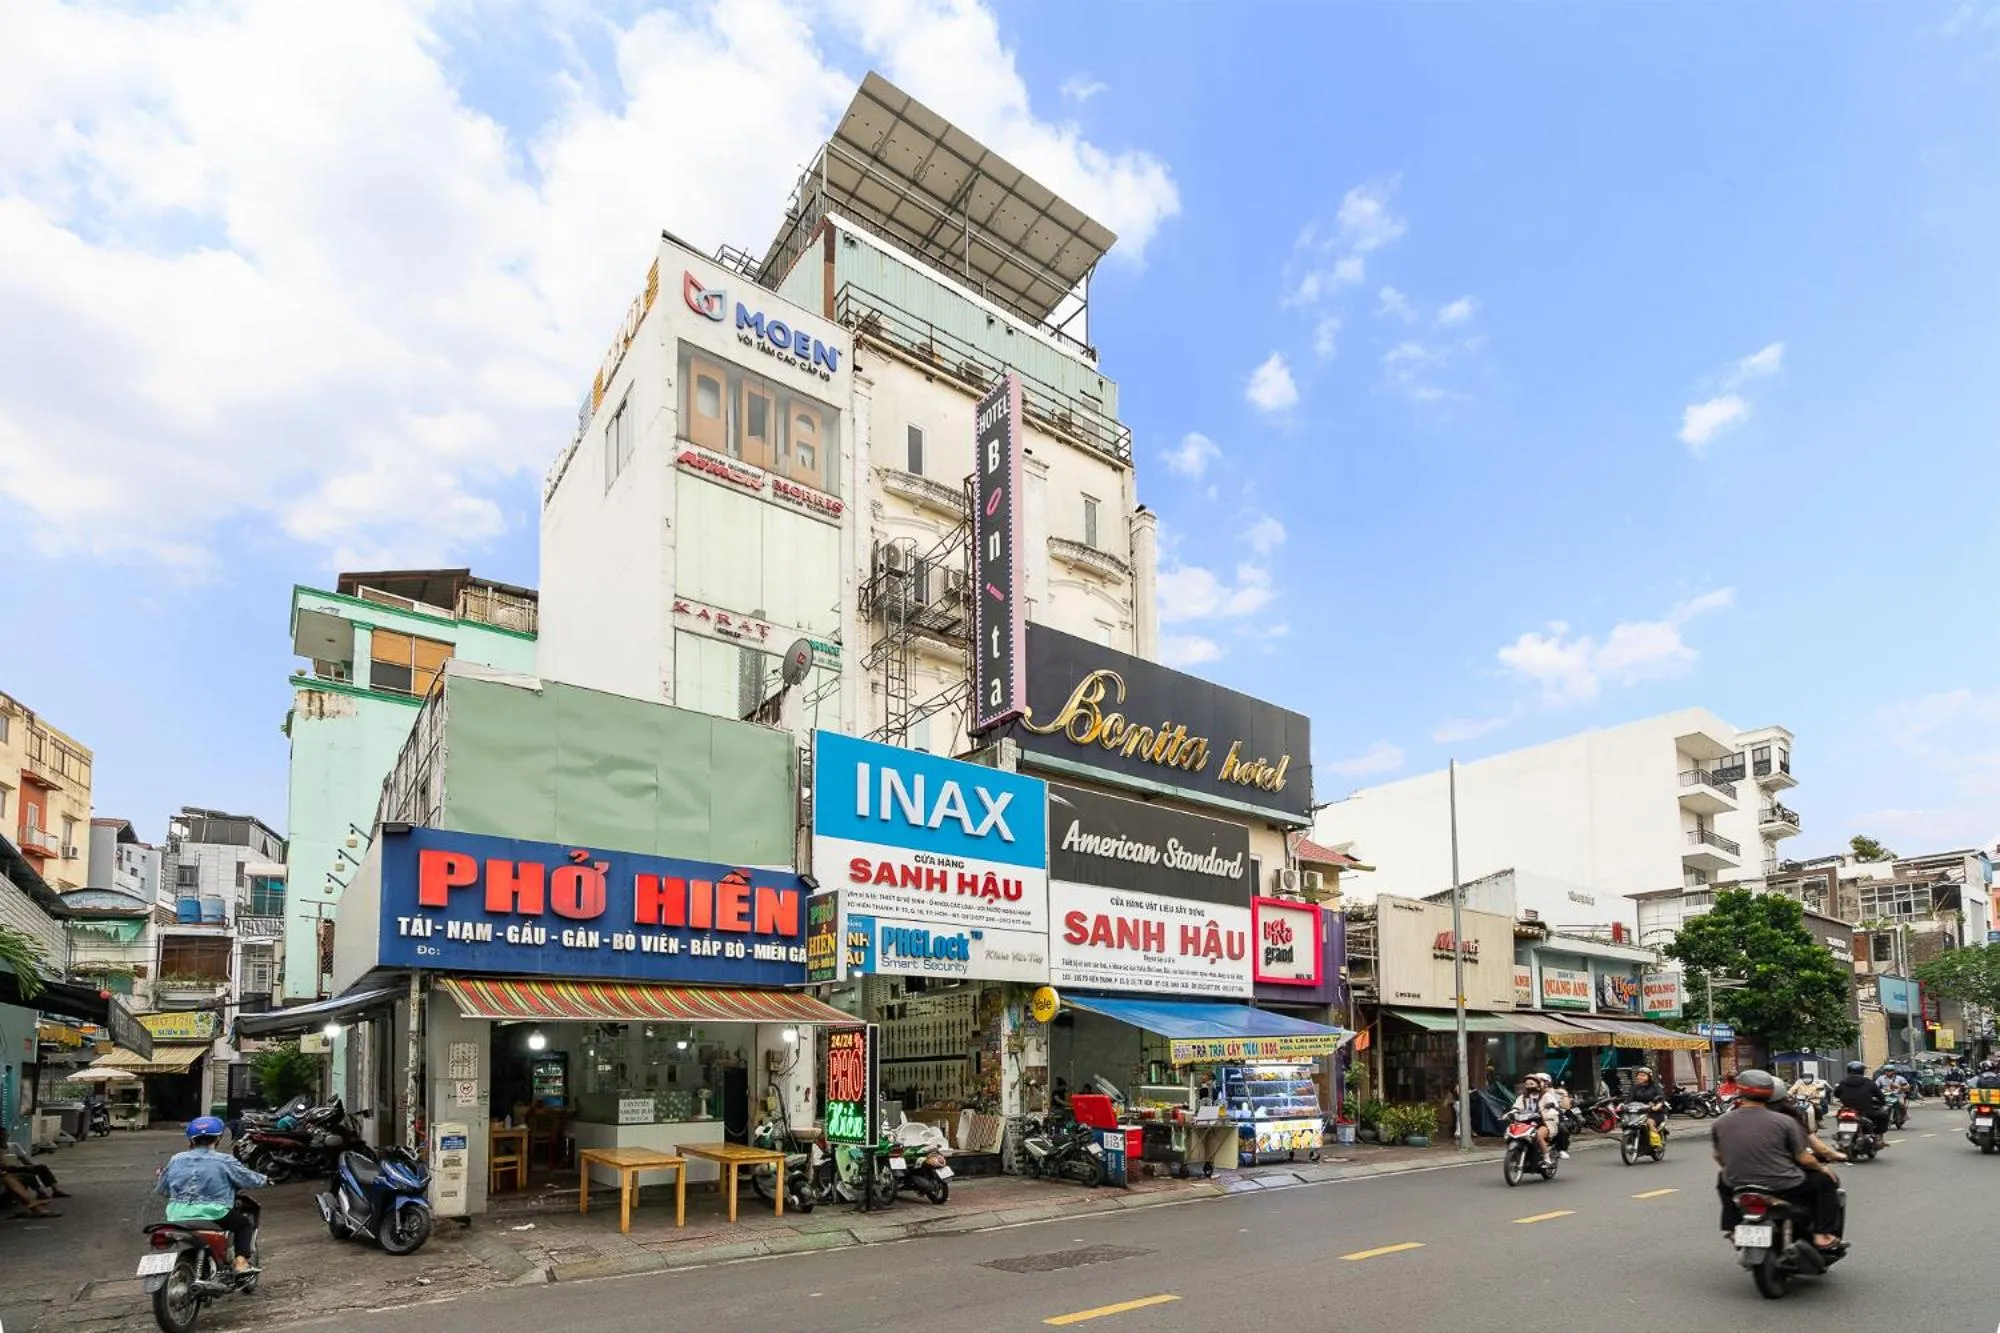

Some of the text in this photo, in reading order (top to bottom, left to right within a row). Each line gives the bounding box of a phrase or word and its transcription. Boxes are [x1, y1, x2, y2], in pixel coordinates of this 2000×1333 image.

[736, 301, 838, 373] MOEN
[980, 394, 1010, 436] HOTEL
[673, 600, 770, 639] KARAT
[1019, 669, 1212, 773] Bonita
[856, 762, 1016, 843] INAX
[914, 852, 965, 869] CỬA HÀNG
[1061, 819, 1244, 880] American Standard
[418, 848, 799, 936] PHỞ HIỀN
[849, 857, 1023, 906] SANH HẬU
[397, 913, 432, 937] TÁI
[447, 920, 493, 944] NẠM
[507, 920, 546, 945] GẦU
[562, 926, 600, 949] GÂN
[612, 930, 635, 951] BÒ
[641, 933, 679, 954] VIÊN
[690, 934, 723, 956] BẮP
[725, 940, 745, 959] BÒ
[754, 941, 787, 961] MIẾN
[789, 944, 807, 963] GÀ
[881, 926, 969, 961] PHGLock
[1063, 911, 1165, 953] SANH
[1180, 919, 1245, 965] HẬU
[881, 956, 968, 975] Smart Security
[1034, 997, 1052, 1011] Yale
[1545, 978, 1572, 996] QUANG
[1643, 983, 1676, 997] QUANG
[1648, 999, 1673, 1009] ANH
[831, 1035, 853, 1048] 24/24
[829, 1032, 864, 1102] PHỞ
